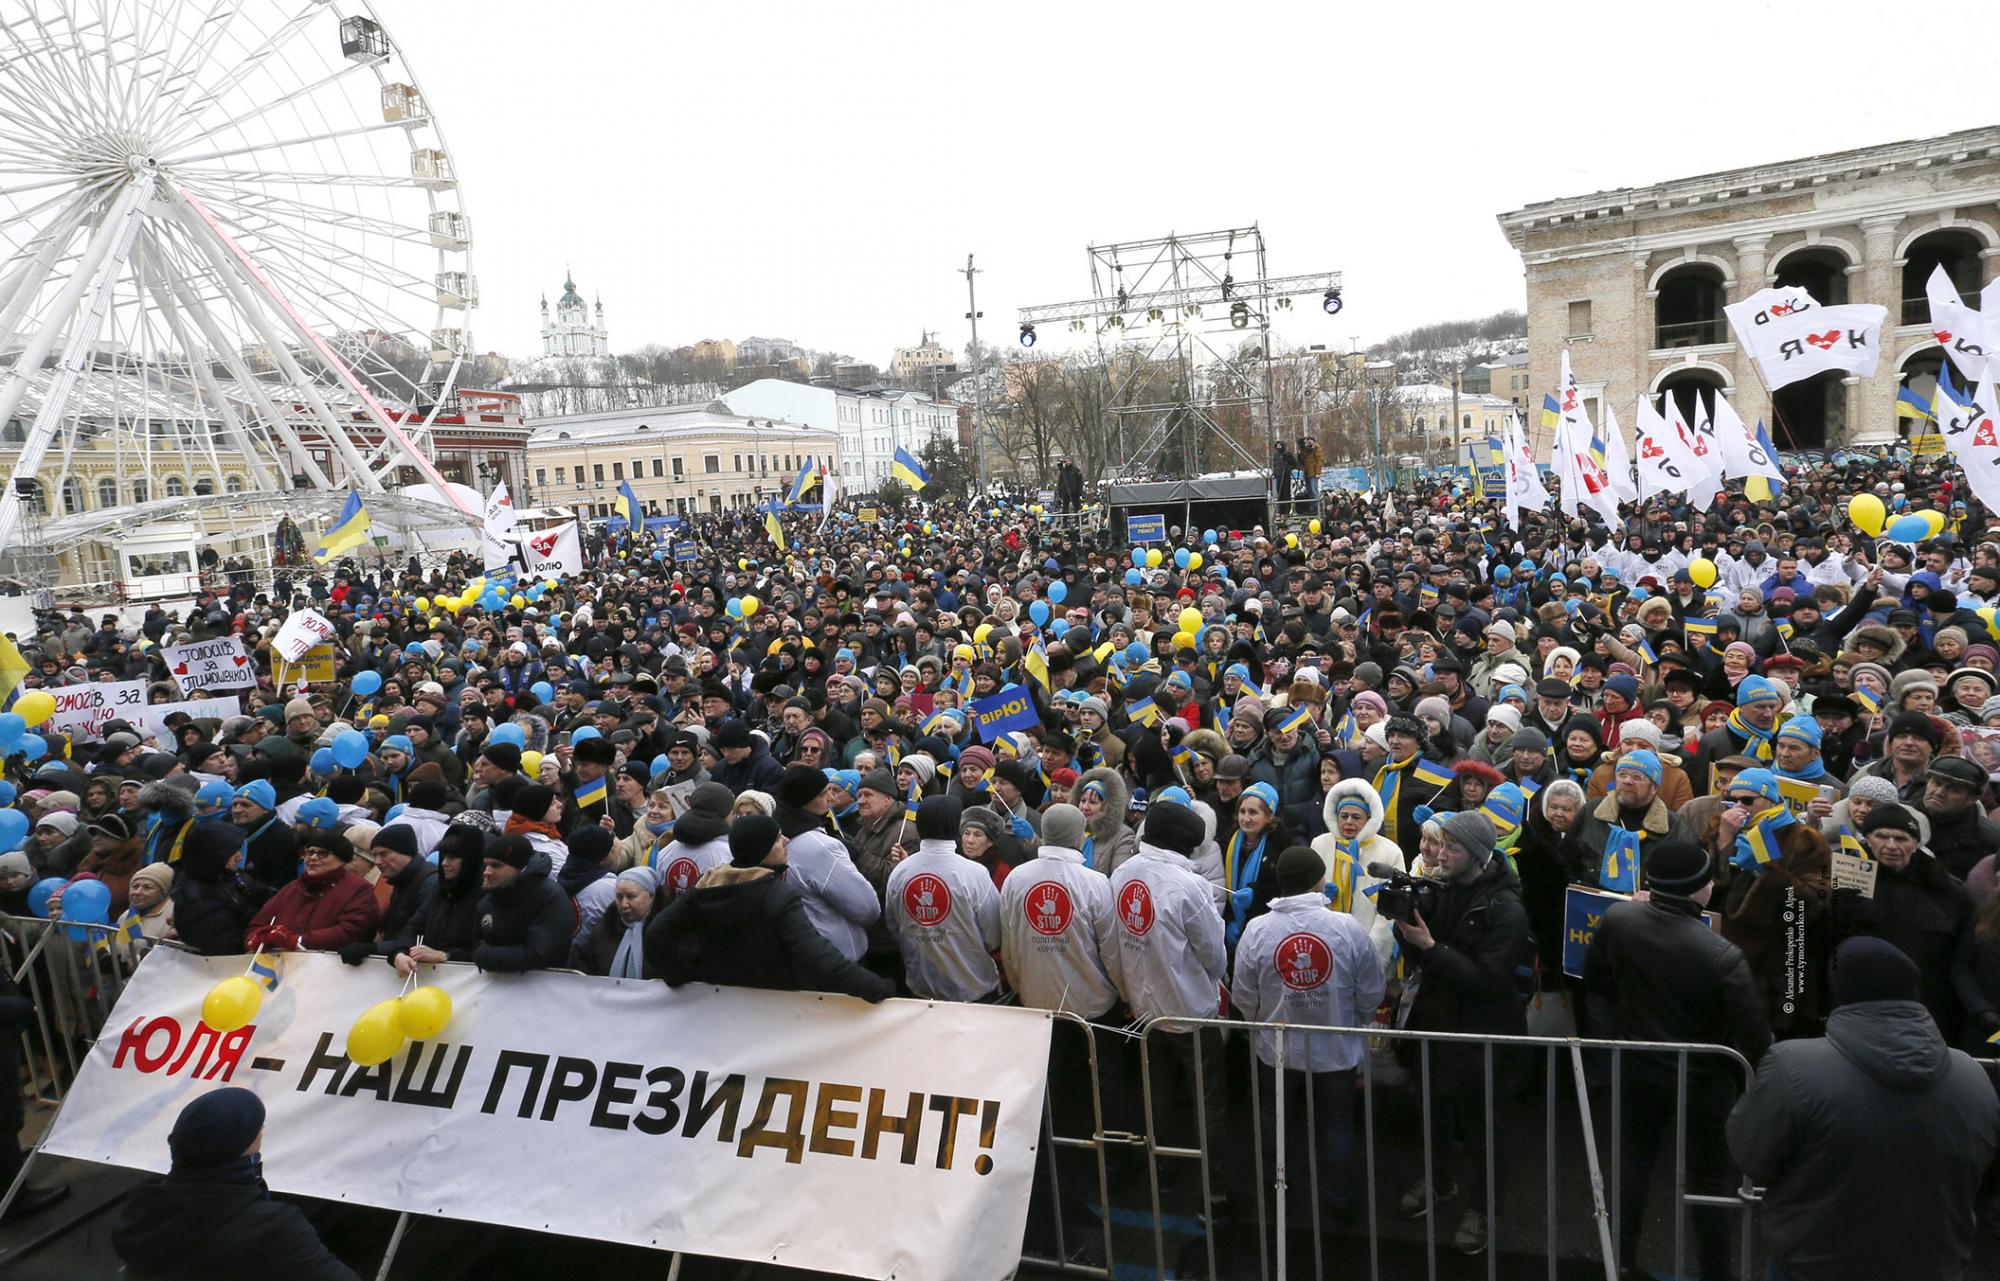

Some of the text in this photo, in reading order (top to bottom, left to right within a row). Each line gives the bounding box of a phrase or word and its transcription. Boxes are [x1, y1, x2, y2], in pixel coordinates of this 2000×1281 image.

[535, 542, 552, 550] ЗА
[535, 562, 562, 572] ЮЛЮ
[980, 697, 1028, 725] ВІРЮ!
[915, 906, 939, 919] STOP
[1037, 915, 1062, 929] STOP
[1128, 912, 1144, 929] STOP
[1291, 969, 1318, 984] STOP
[112, 1016, 256, 1082] ЮЛЯ
[296, 1032, 474, 1109] НАШ
[480, 1049, 1001, 1176] ПРЕЗИДЕНТ!
